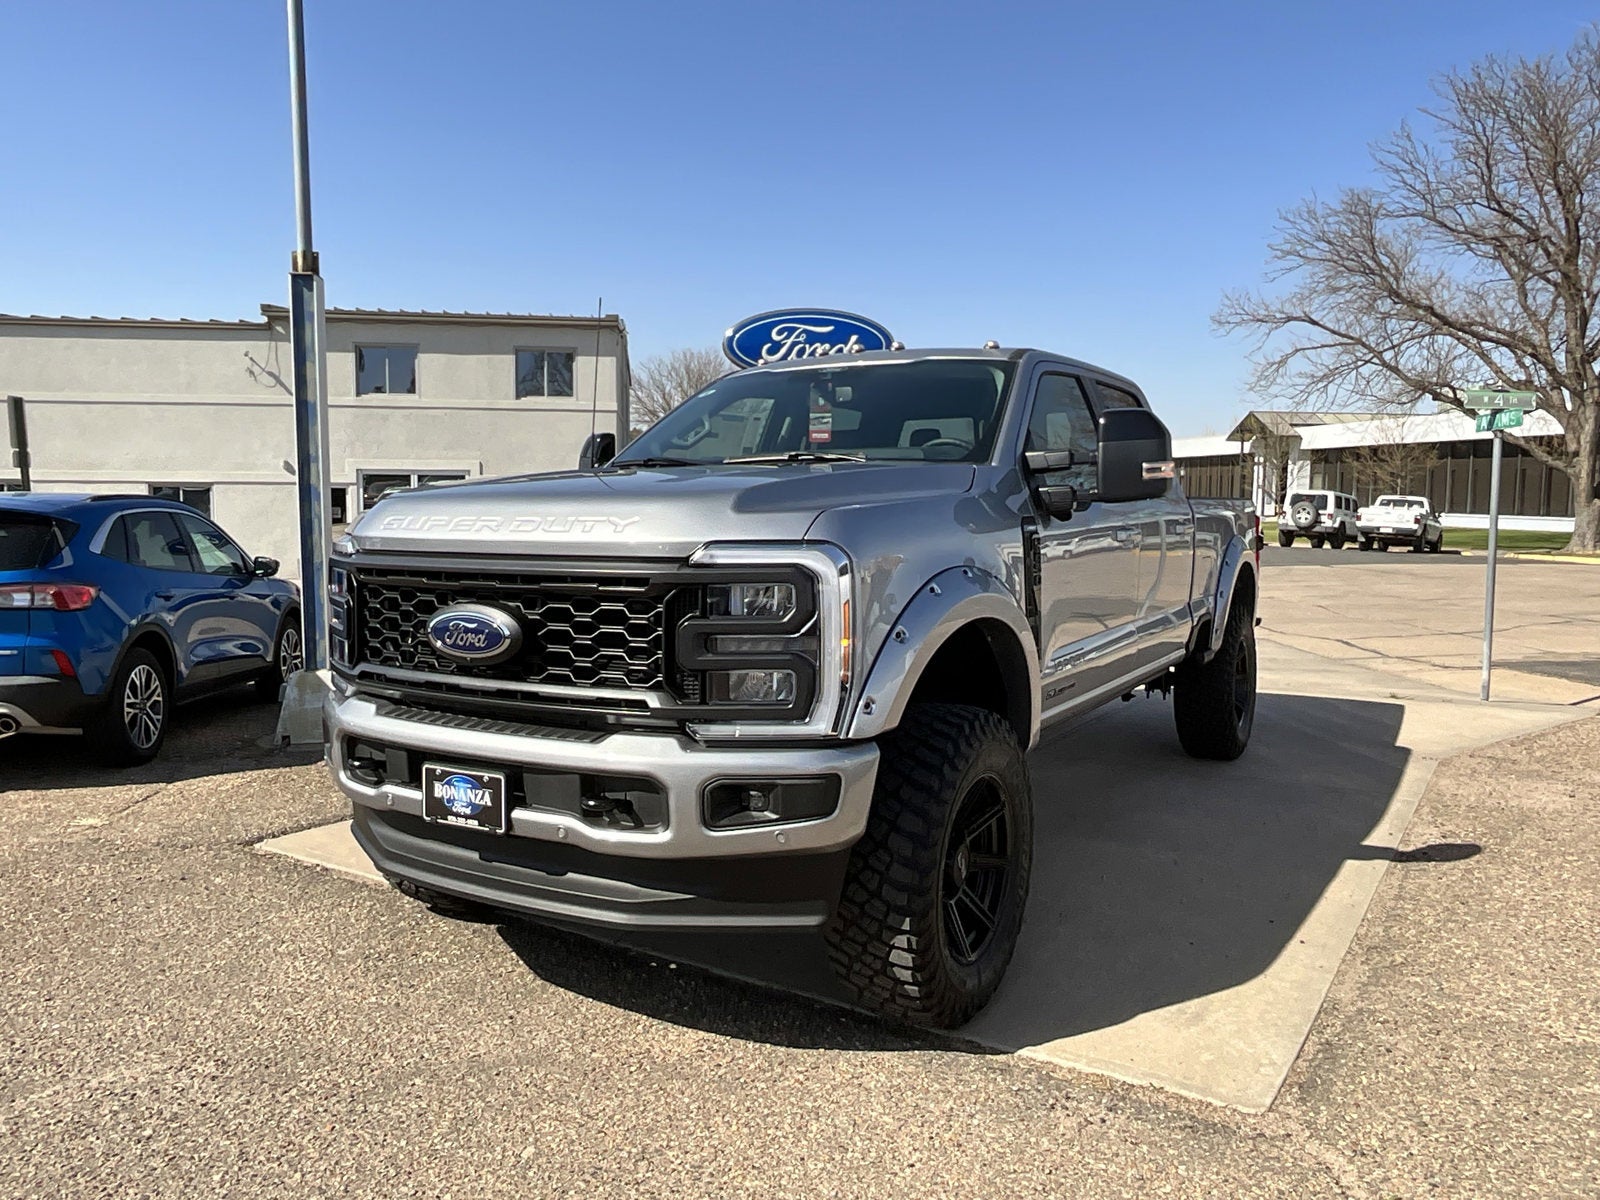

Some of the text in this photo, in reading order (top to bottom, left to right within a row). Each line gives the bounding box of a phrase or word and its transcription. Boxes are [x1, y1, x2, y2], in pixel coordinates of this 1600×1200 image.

[761, 323, 860, 361] Ford
[1494, 393, 1504, 407] 4
[1480, 411, 1517, 431] AAMS
[380, 514, 641, 534] SUPER DUTY
[444, 620, 489, 649] Ford
[433, 780, 493, 807] BONANZA
[451, 801, 472, 816] Ford
